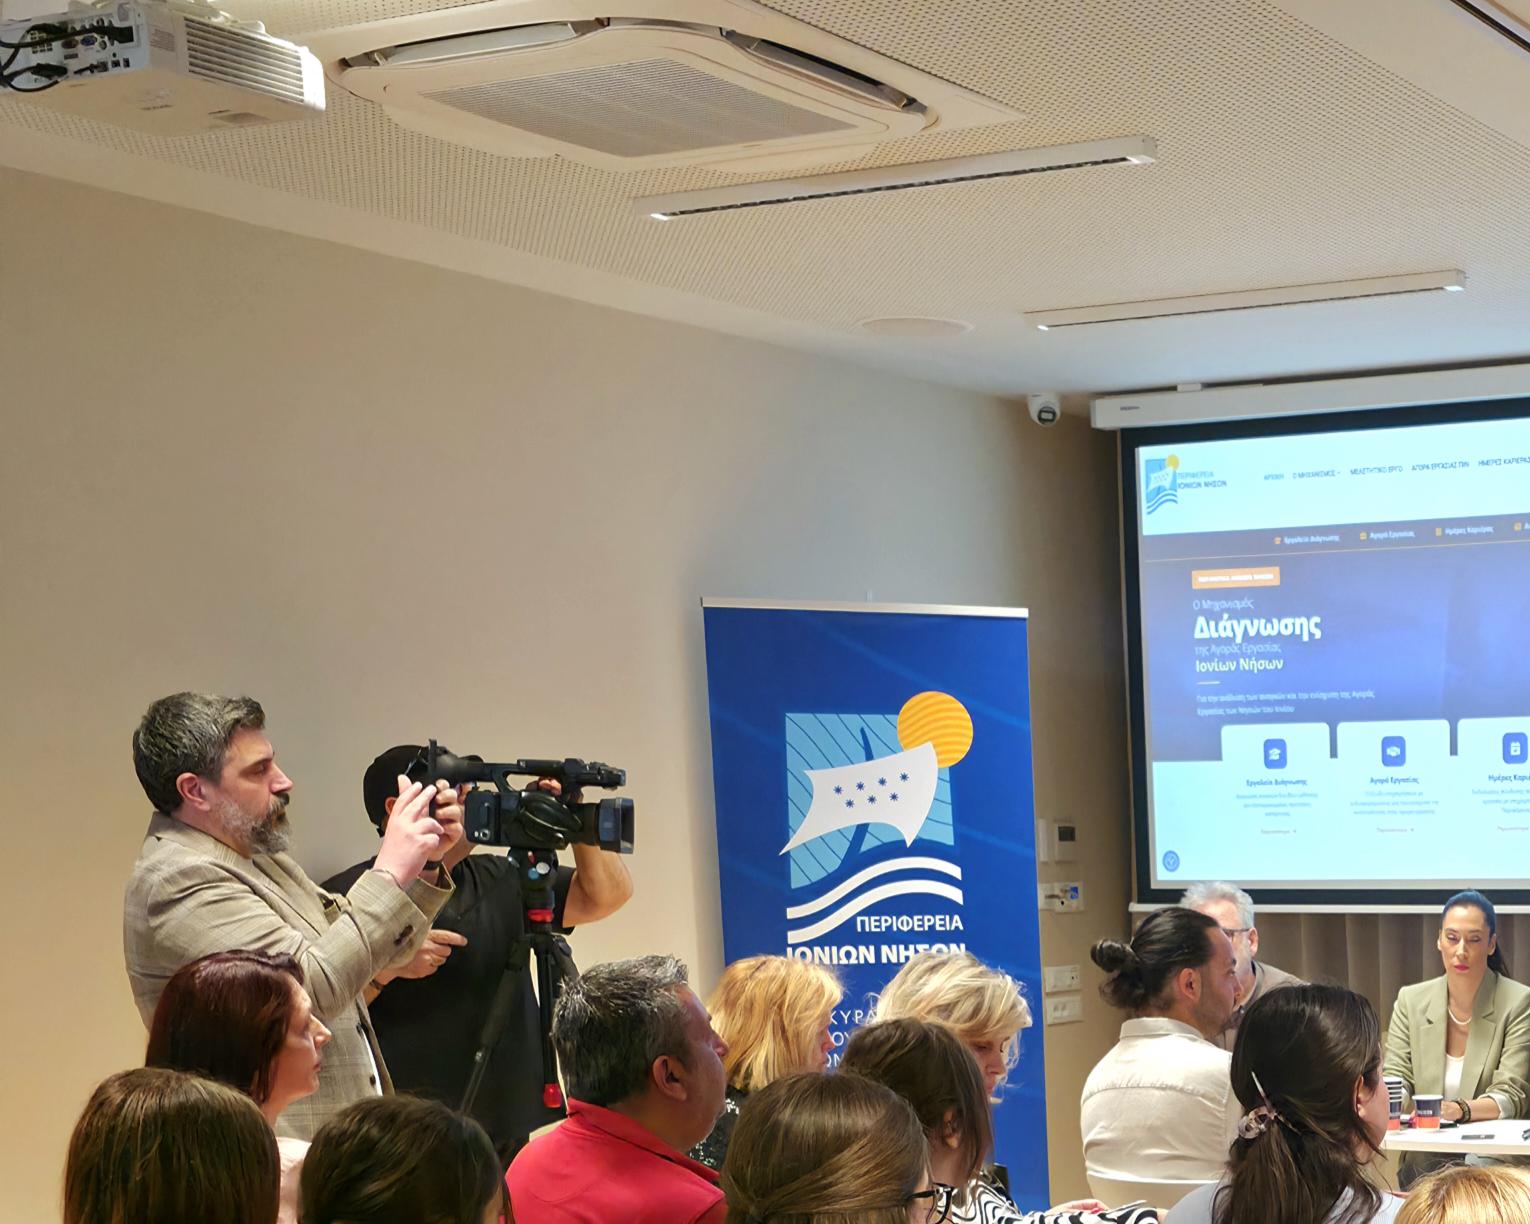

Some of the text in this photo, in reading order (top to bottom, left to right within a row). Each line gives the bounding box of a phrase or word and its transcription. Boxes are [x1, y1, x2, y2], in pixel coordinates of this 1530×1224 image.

[1193, 612, 1322, 644] Διάγνωσης
[1195, 656, 1284, 673] Ιονίων Νήσων
[856, 914, 964, 933] ΠΕΡΙΦΕΡΕΙΑ
[786, 945, 876, 965] ΙΟΝΙΩΝ
